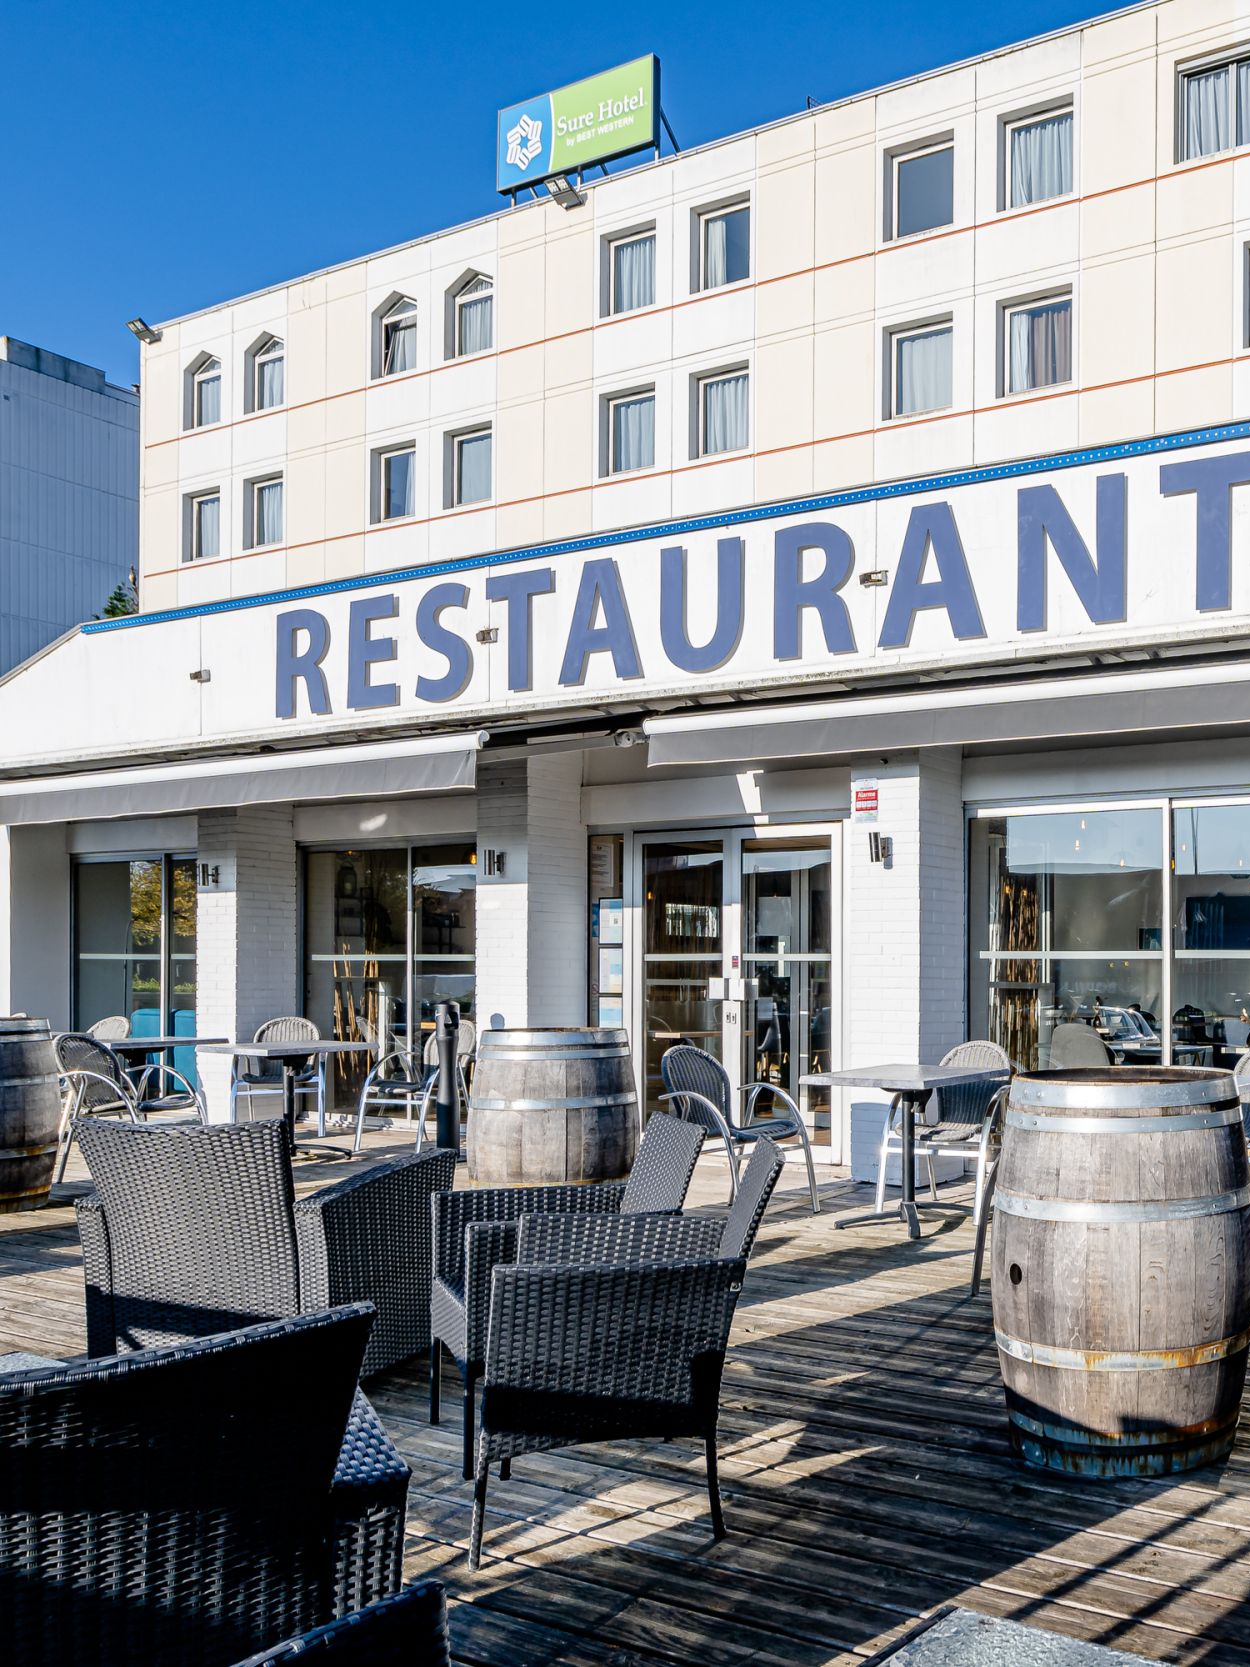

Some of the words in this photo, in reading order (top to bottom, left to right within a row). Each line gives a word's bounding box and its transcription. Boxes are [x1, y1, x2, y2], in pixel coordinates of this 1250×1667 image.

[557, 111, 594, 136] Sure
[598, 86, 644, 122] Hotel
[566, 137, 575, 147] by
[576, 127, 596, 143] BEST
[597, 115, 634, 136] WESTERN
